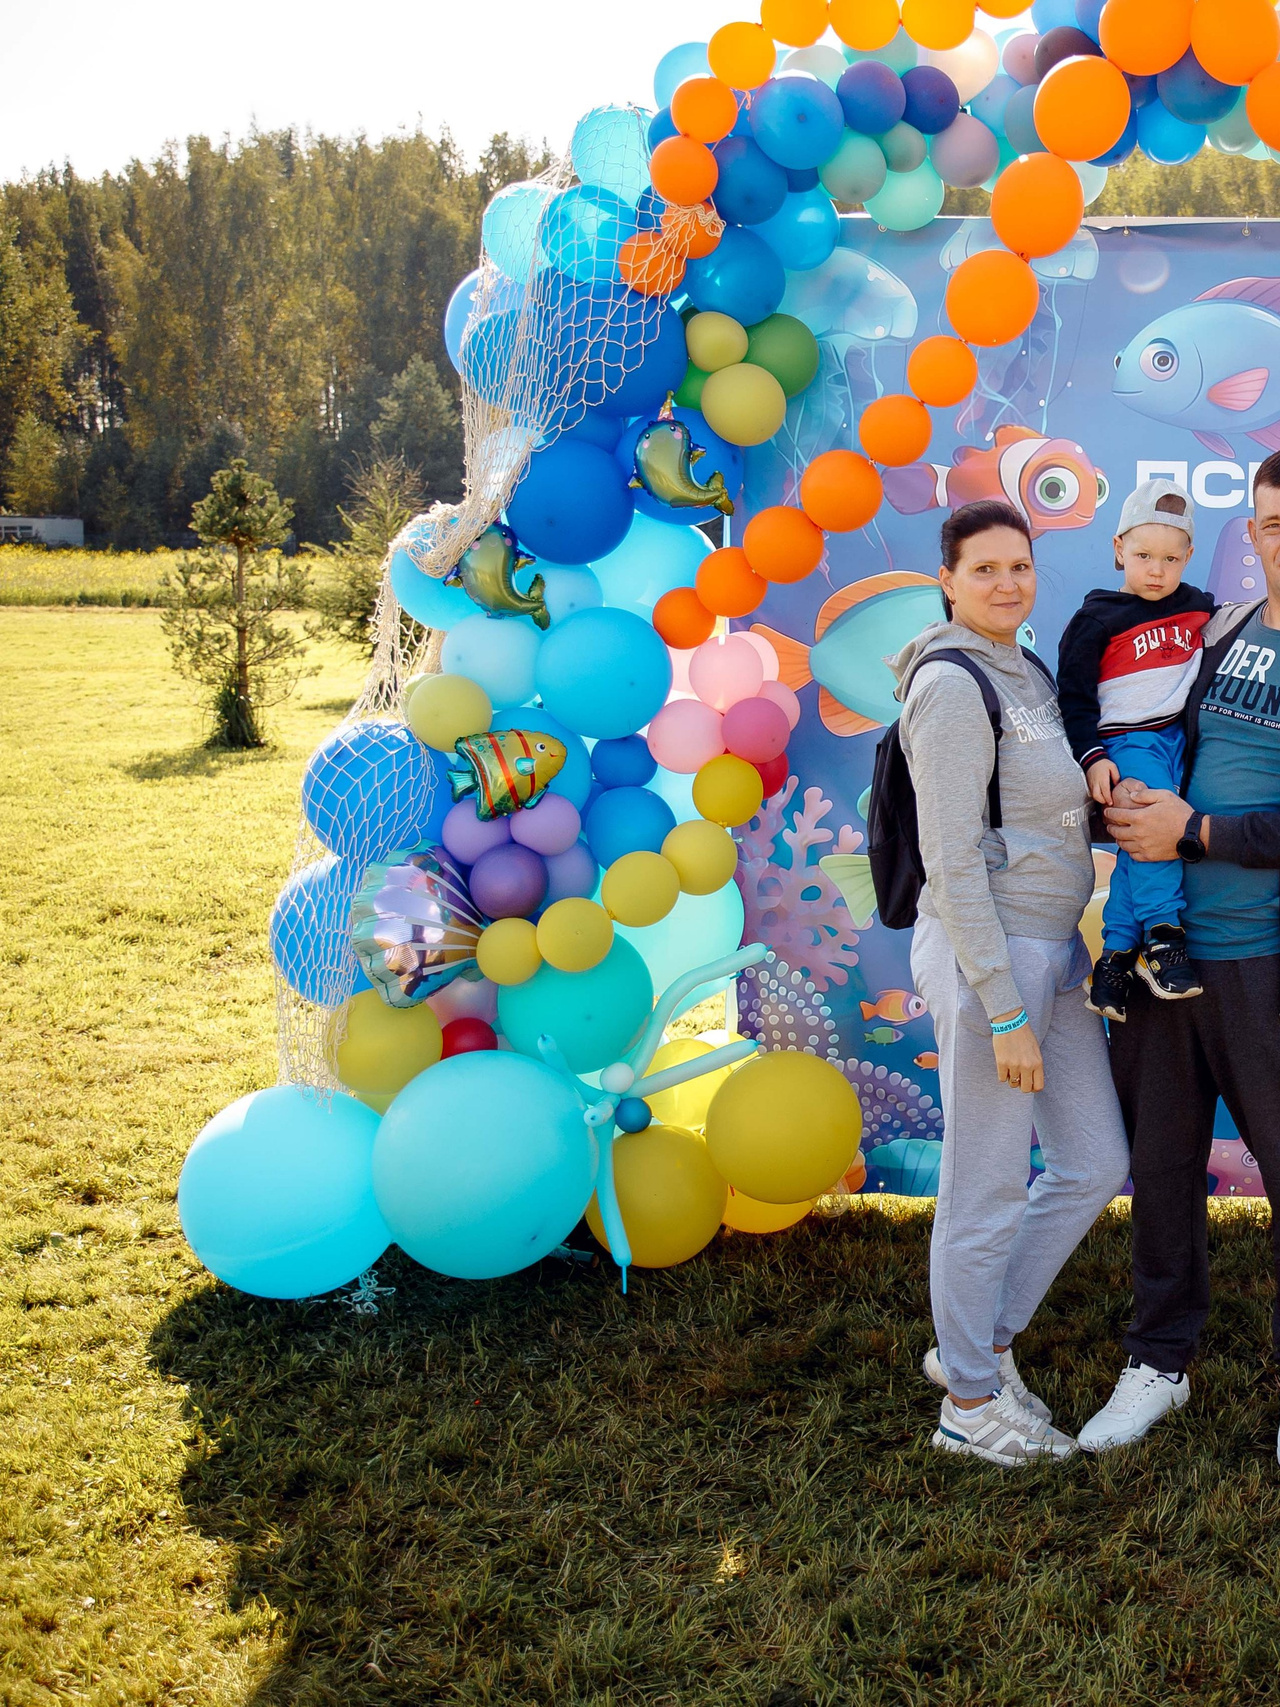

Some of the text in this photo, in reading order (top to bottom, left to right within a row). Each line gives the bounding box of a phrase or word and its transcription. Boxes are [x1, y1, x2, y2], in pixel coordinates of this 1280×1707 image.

[1136, 460, 1262, 509] ПС
[1218, 707, 1233, 716] FOR
[1234, 711, 1254, 722] WHAT
